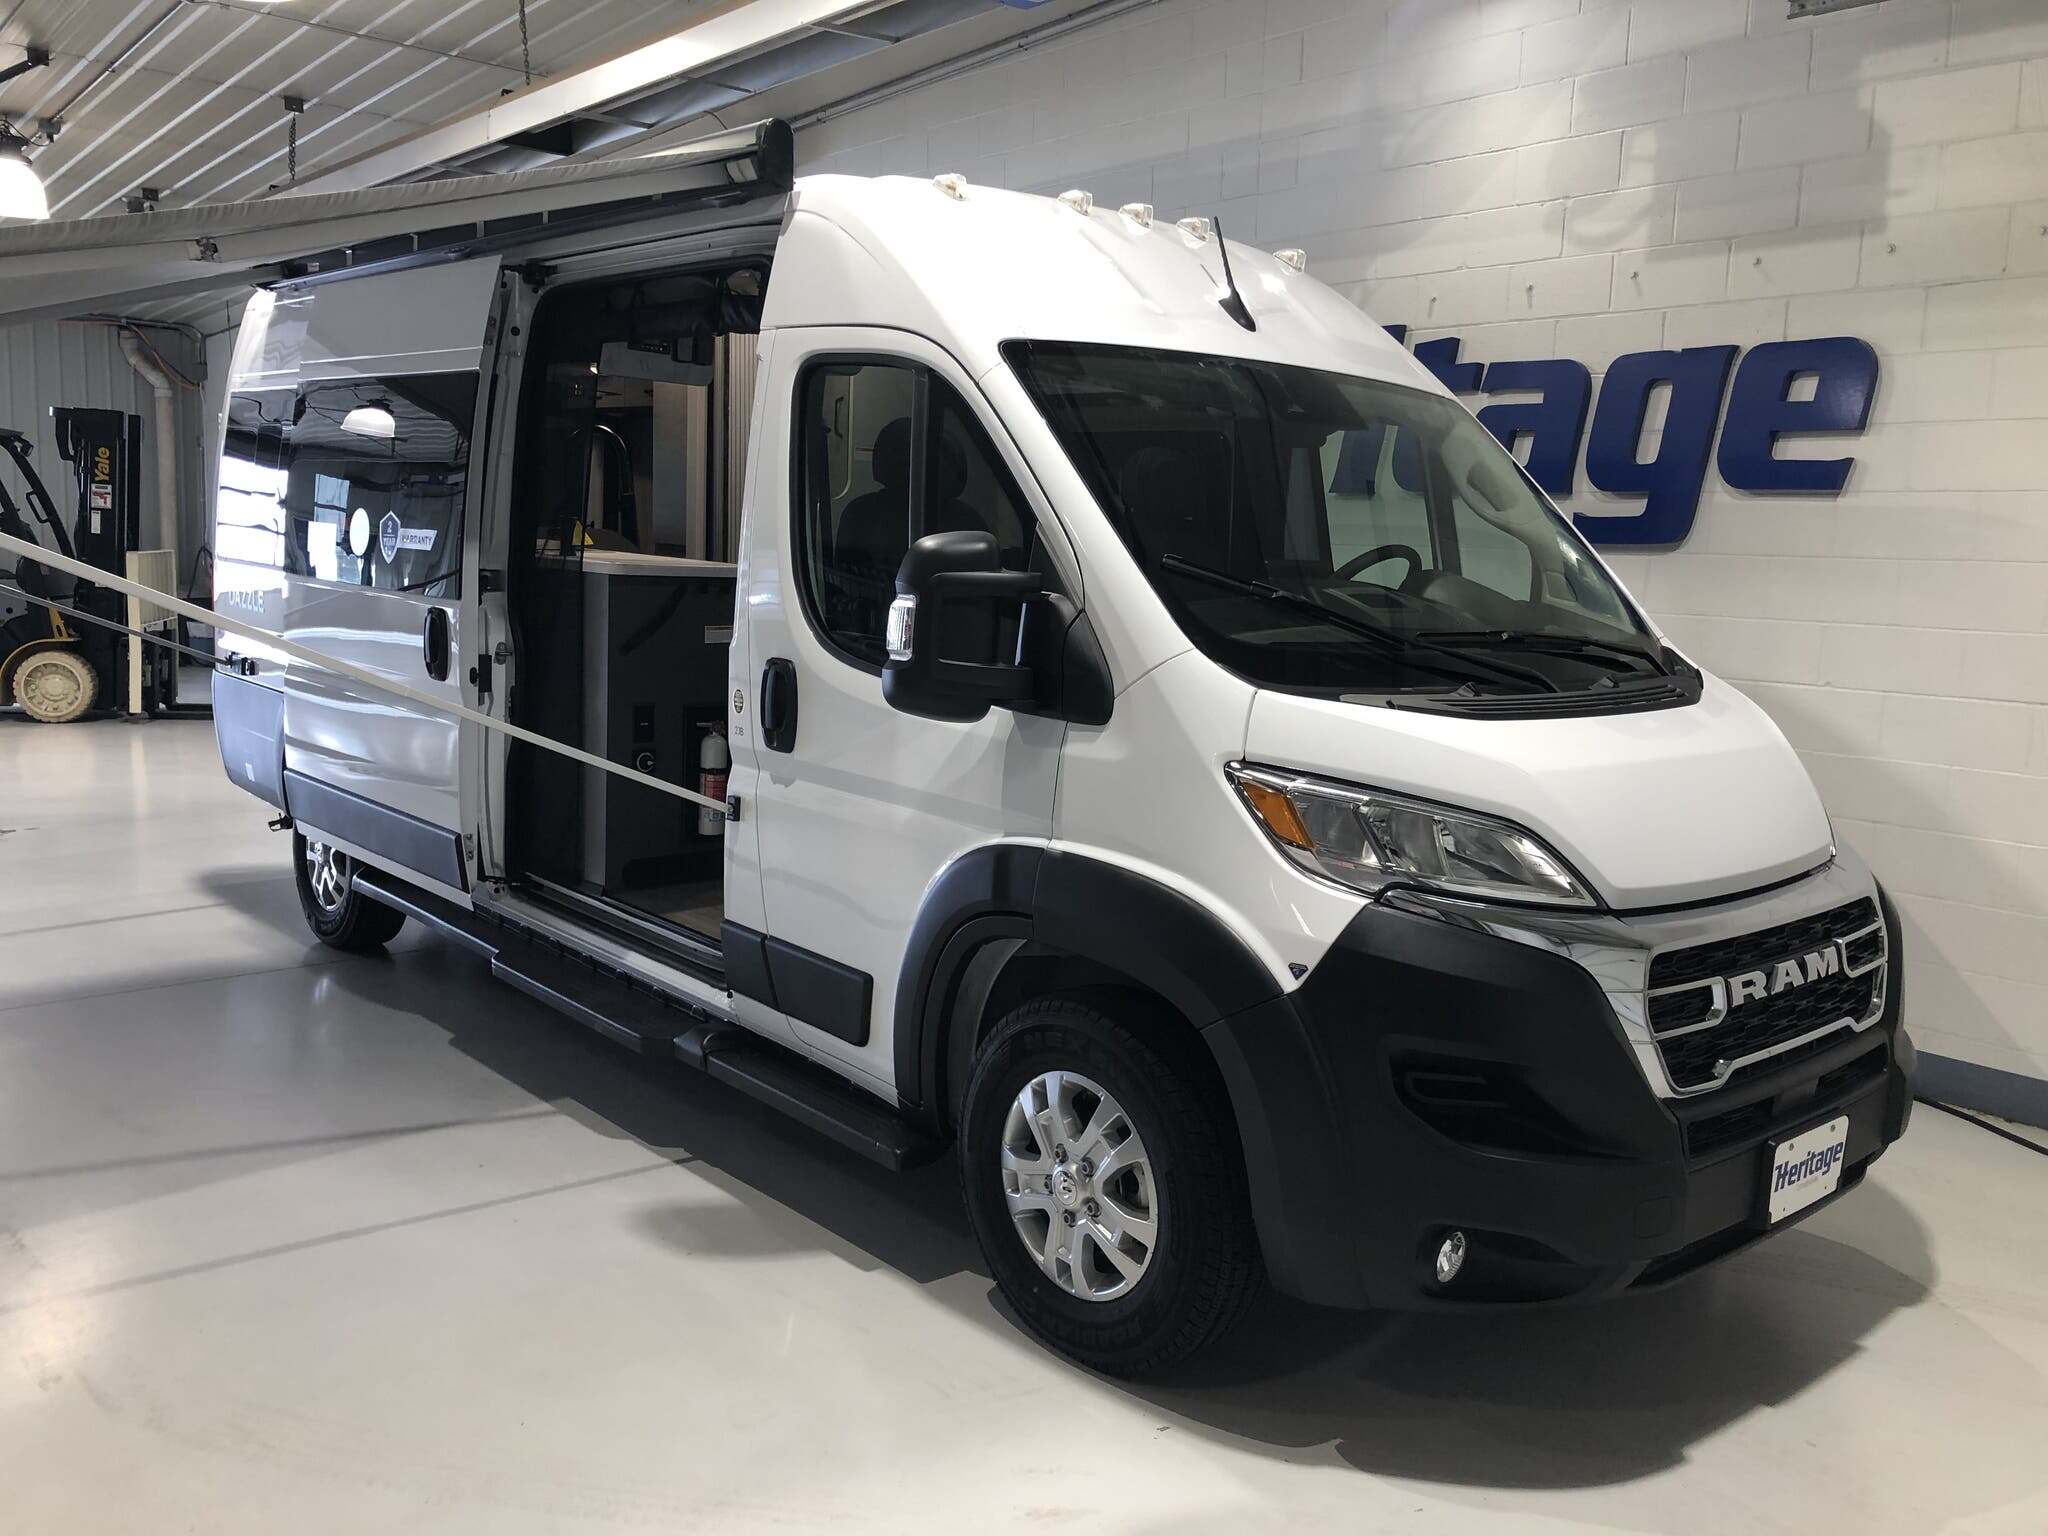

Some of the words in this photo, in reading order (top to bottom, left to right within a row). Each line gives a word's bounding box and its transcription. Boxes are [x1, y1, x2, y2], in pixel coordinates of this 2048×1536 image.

[94, 446, 110, 481] Yale
[1727, 945, 1840, 1008] RAM
[1774, 1141, 1844, 1193] Heritage
